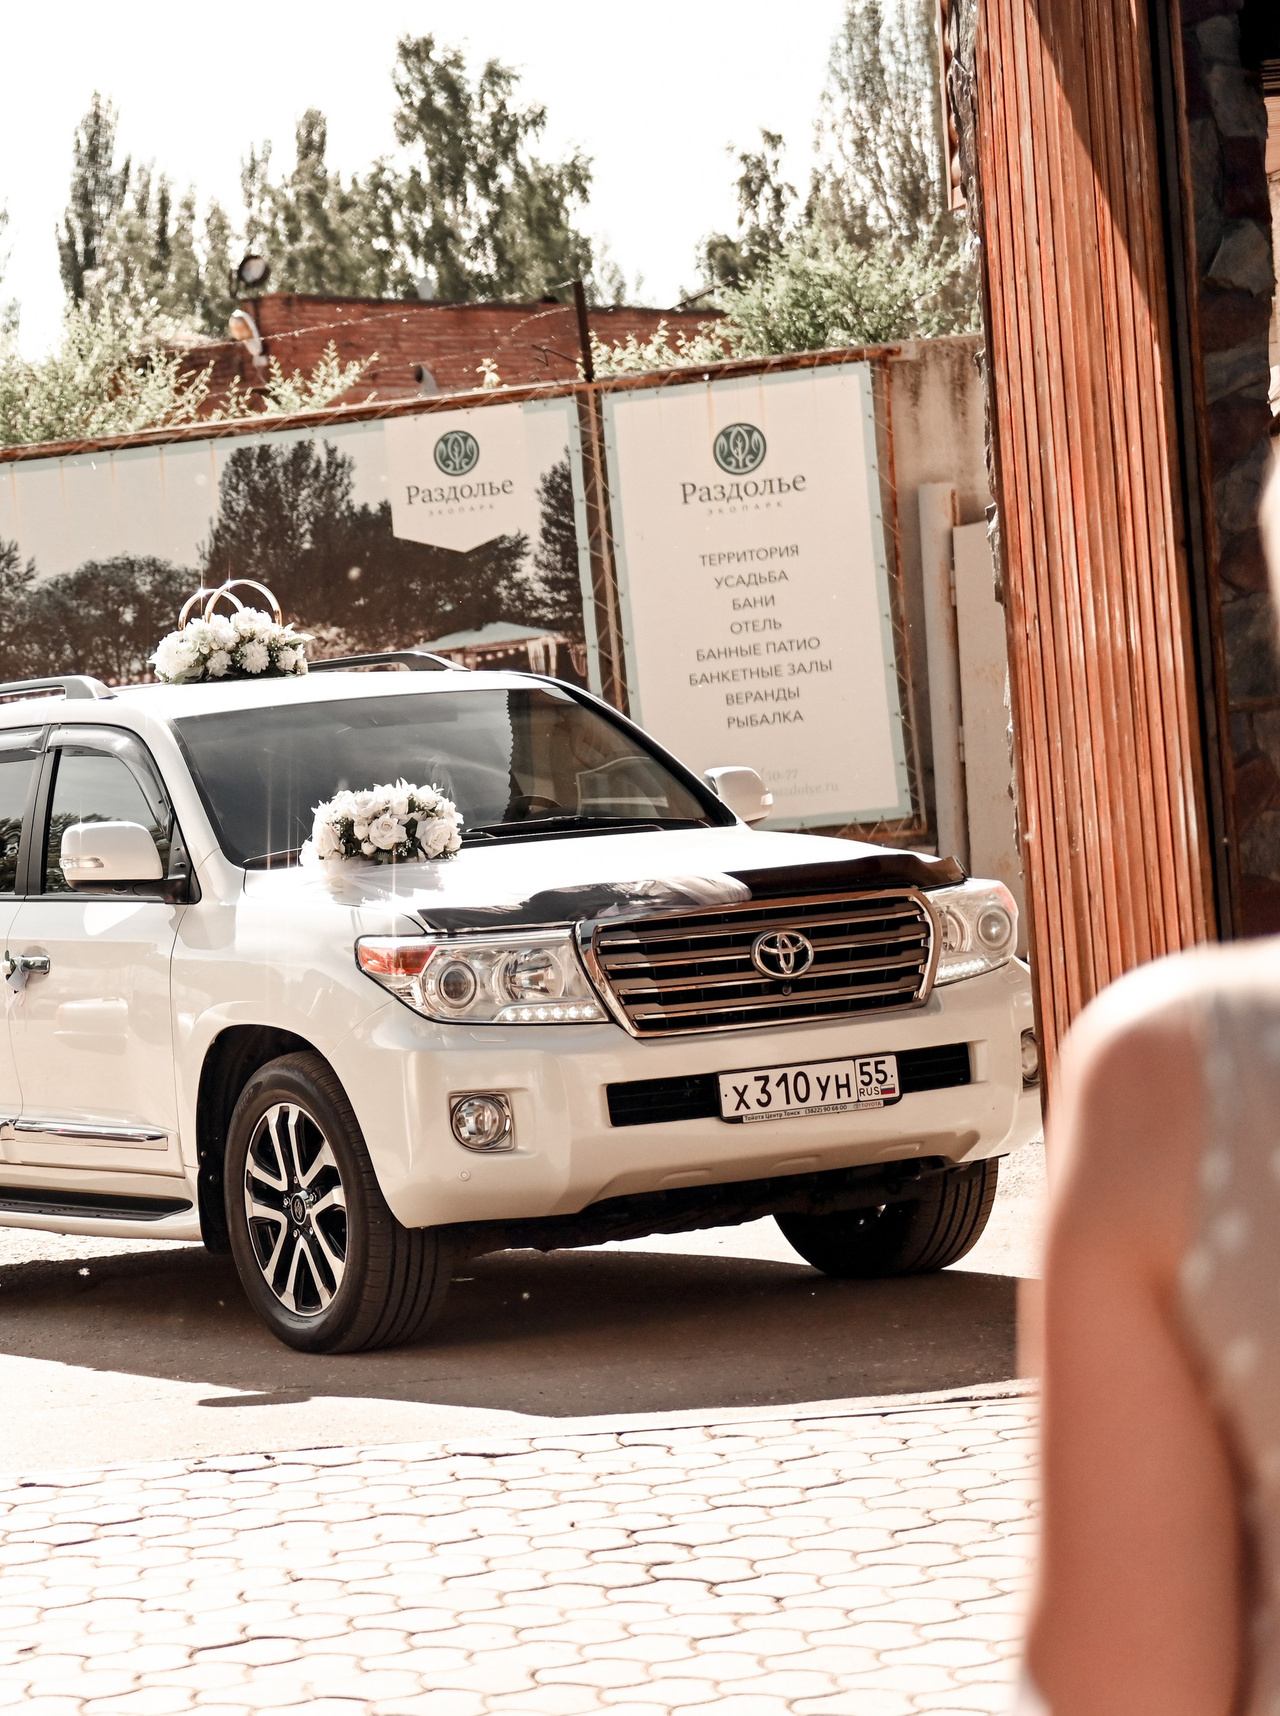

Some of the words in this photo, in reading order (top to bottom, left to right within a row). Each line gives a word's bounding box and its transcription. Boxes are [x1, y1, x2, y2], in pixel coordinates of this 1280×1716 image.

[405, 479, 514, 505] Раздолье
[680, 473, 807, 505] Раздолье
[429, 503, 494, 516] ЭКОПАРК
[707, 501, 783, 515] ЭКОПАРК
[699, 544, 799, 567] ТЕРРИТОРИЯ
[714, 570, 789, 589] УСАДЬБА
[732, 594, 775, 611] БАНИ
[730, 618, 782, 635] ОТЕЛЬ
[696, 643, 762, 662] БАННЫЕ
[766, 636, 820, 654] ПАТИО
[689, 664, 783, 686] БАНКЕТНЫЕ
[787, 659, 833, 676] ЗАЛЫ
[726, 686, 800, 706] ВЕРАНДЫ
[727, 710, 804, 728] РЫБАЛКА
[858, 1060, 888, 1087] 55
[859, 1086, 880, 1097] RUS
[744, 1114, 765, 1122] Тойота
[765, 1112, 783, 1120] Центр
